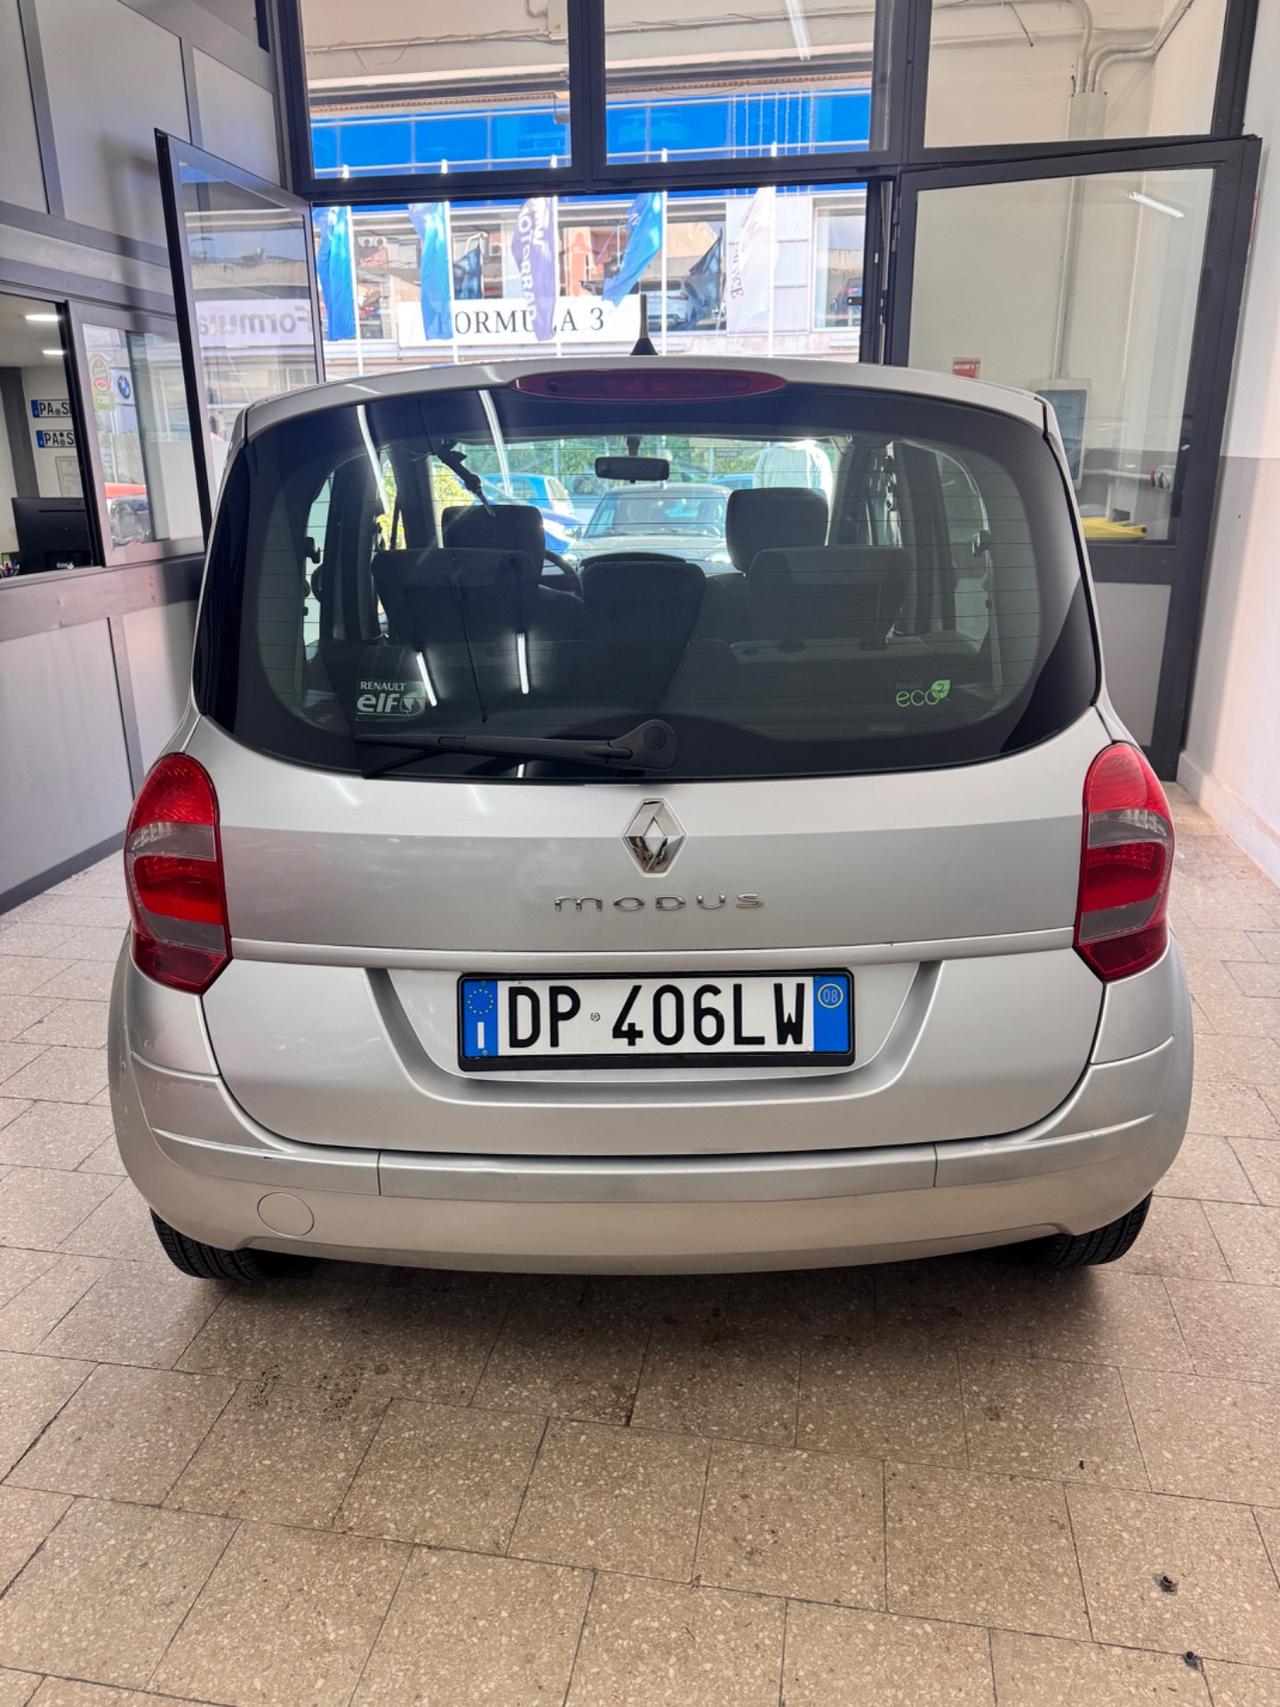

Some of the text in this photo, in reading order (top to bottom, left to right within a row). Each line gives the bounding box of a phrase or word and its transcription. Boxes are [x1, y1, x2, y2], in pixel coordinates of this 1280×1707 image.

[434, 307, 605, 336] ORMUA 3
[40, 402, 71, 416] PA S
[44, 432, 59, 446] PA
[360, 681, 407, 691] RENAULT
[357, 693, 400, 713] elf
[554, 893, 765, 912] MODUS
[822, 988, 839, 1004] 08
[508, 982, 805, 1049] DP 406LW
